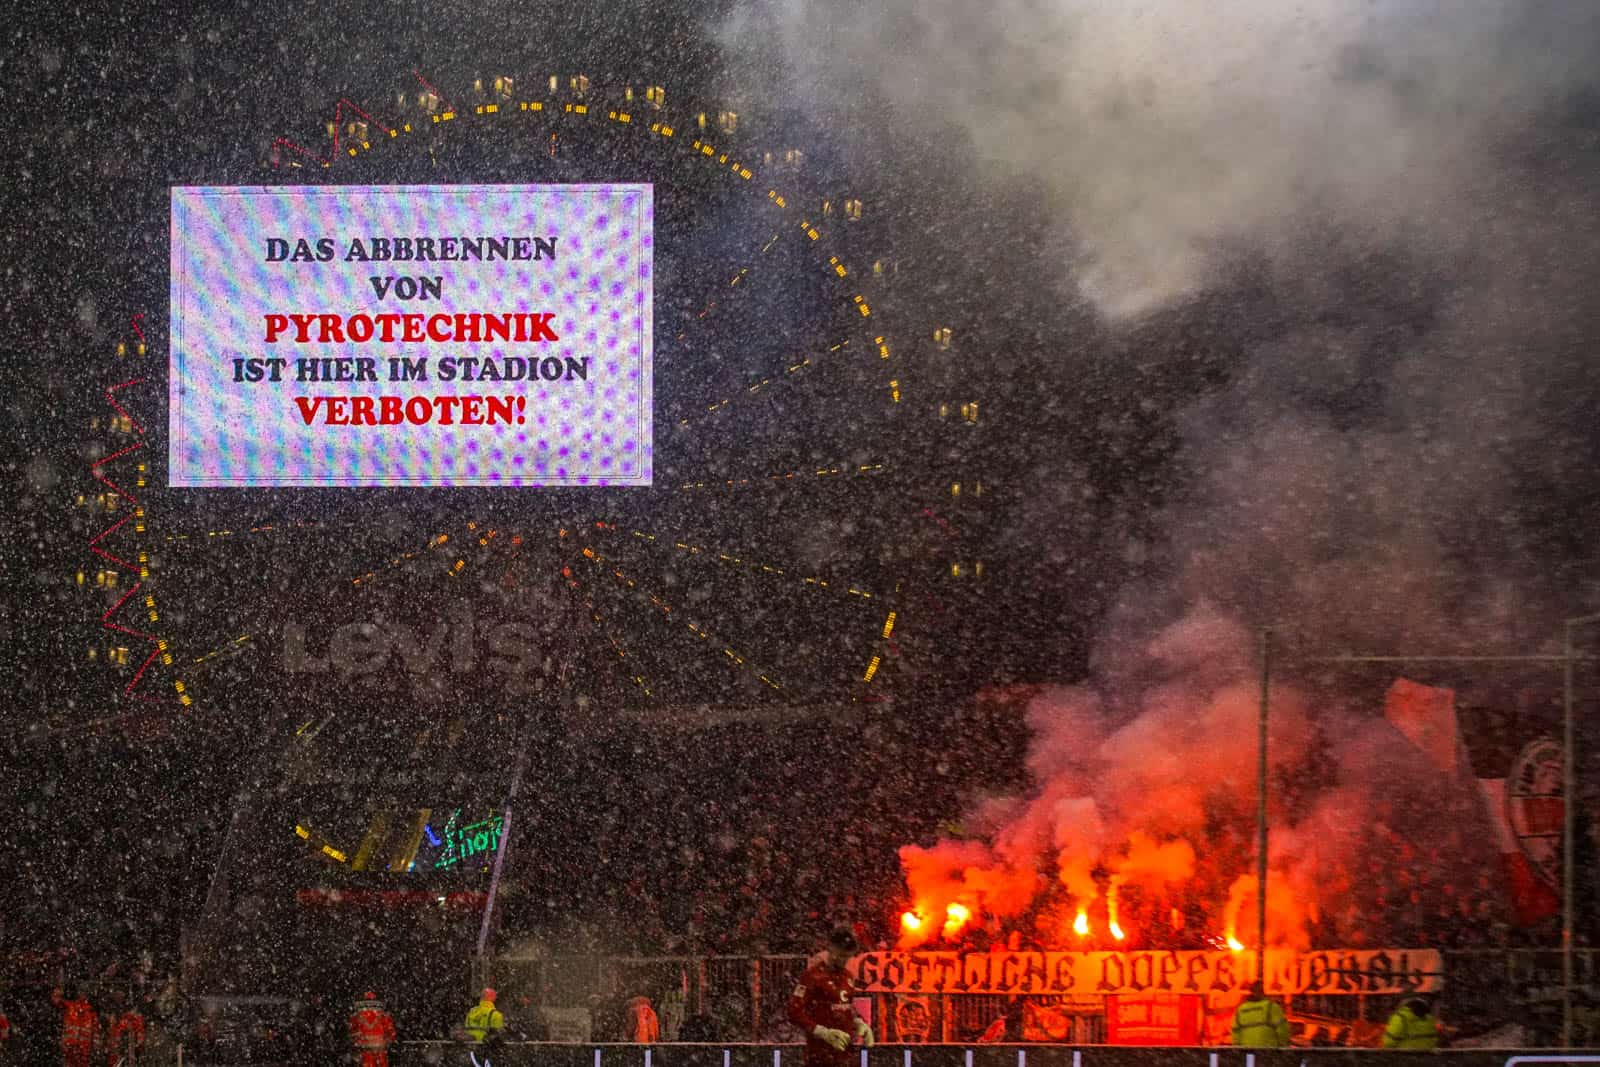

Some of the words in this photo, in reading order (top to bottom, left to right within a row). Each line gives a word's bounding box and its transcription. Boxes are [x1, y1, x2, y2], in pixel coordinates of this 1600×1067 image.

[265, 238, 335, 263] DAS
[344, 236, 558, 262] ABBRENNEN
[369, 276, 444, 301] VON
[263, 313, 560, 344] PYROTECHNIK
[232, 357, 287, 383] IST
[295, 357, 379, 383] HIER
[387, 357, 428, 383] IM
[437, 356, 590, 382] STADION
[295, 395, 527, 426] VERBOTEN!
